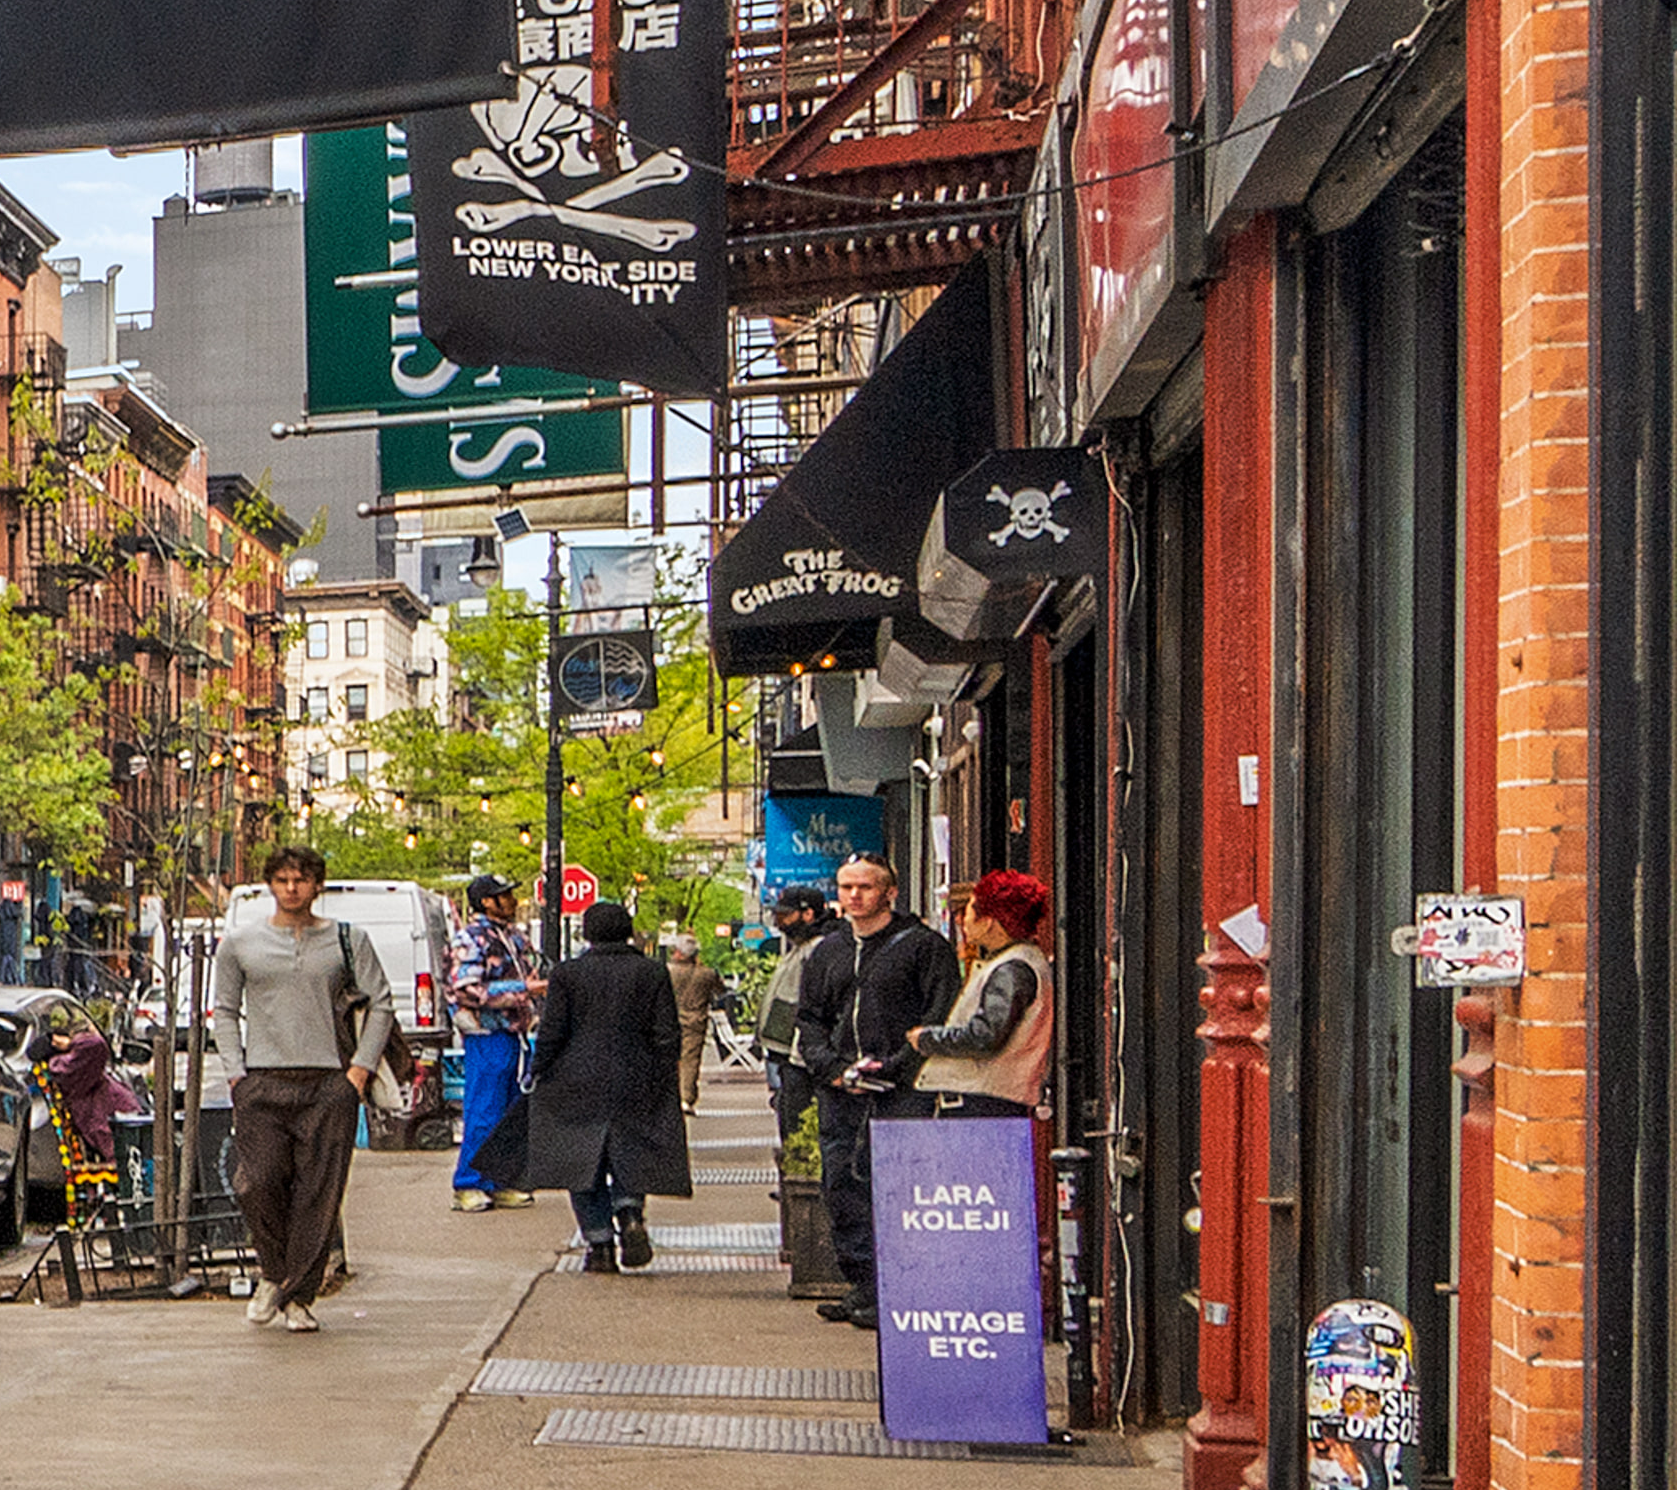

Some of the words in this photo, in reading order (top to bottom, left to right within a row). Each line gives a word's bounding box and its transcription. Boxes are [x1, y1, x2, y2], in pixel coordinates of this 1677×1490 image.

[452, 236, 556, 260] LOWER
[562, 244, 620, 280] EAT
[627, 261, 698, 282] SIDE
[469, 257, 535, 279] NEW
[622, 283, 682, 306] ITY
[782, 547, 844, 575] THE
[730, 572, 820, 615] GREAT
[820, 568, 905, 599] FROG
[913, 1183, 995, 1206] LARA
[902, 1210, 1010, 1231] KOLEJI
[891, 1310, 1026, 1334] VINTAGE
[929, 1336, 997, 1359] ETC.
